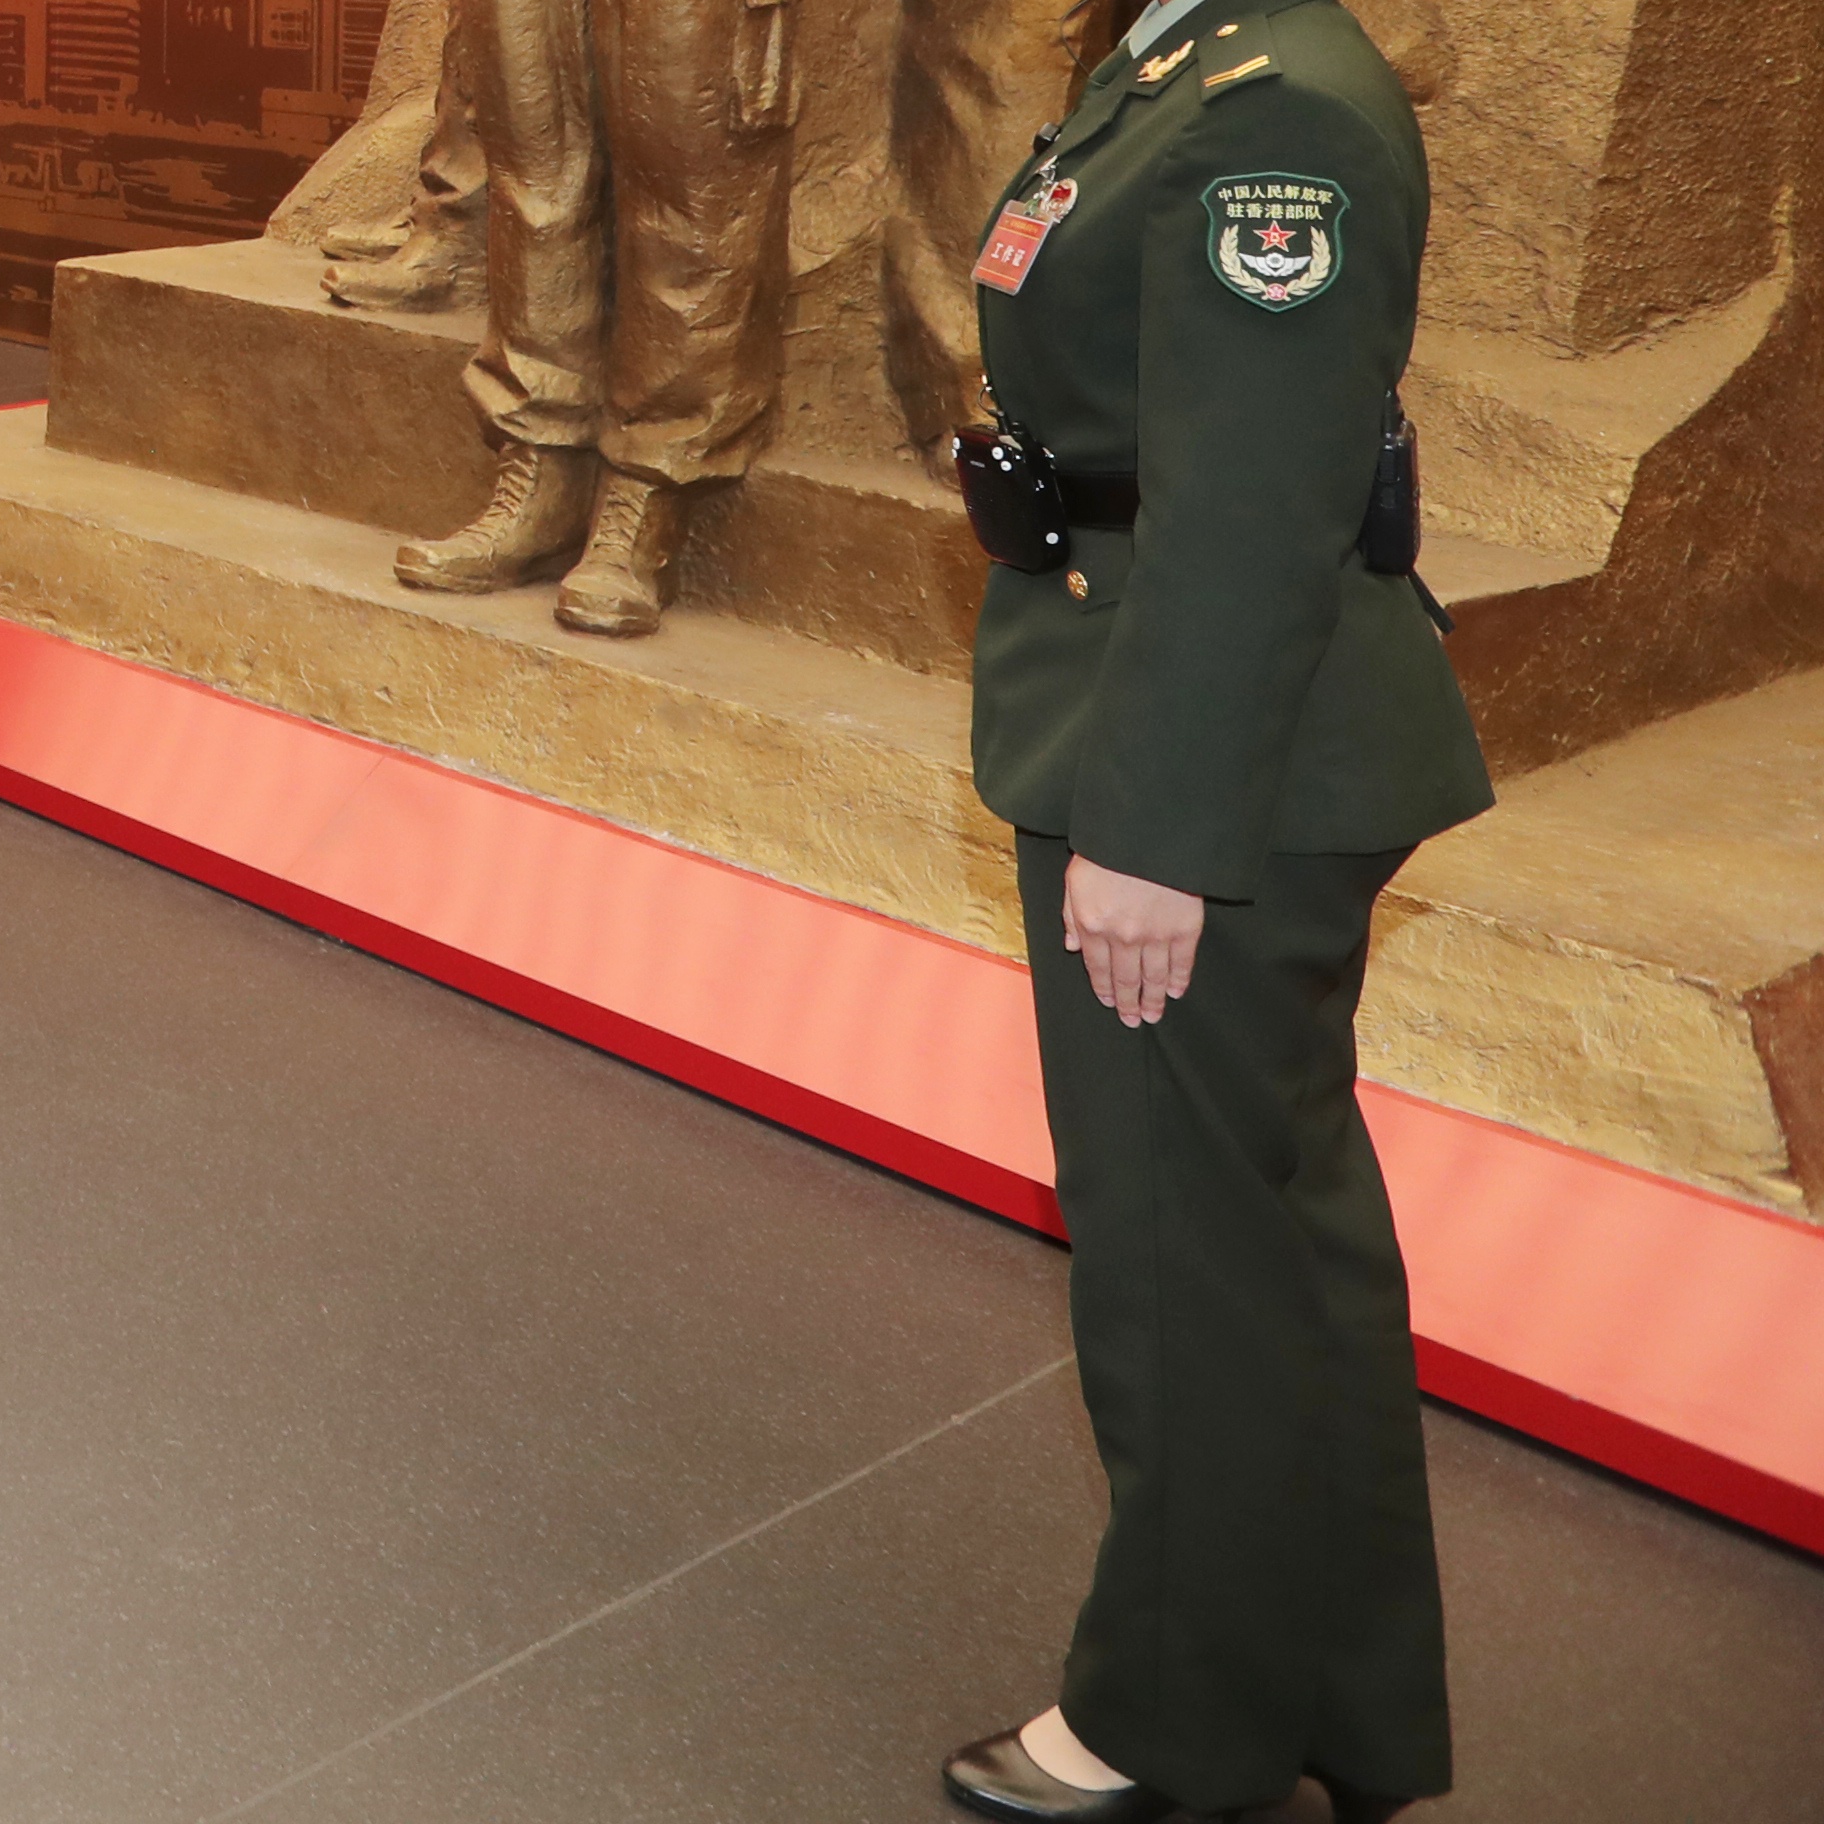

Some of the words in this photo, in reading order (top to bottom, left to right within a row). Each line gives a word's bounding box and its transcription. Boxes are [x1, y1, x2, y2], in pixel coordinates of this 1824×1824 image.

[1218, 184, 1334, 205] 中国人民解放军
[1226, 203, 1324, 220] 驻香港部队
